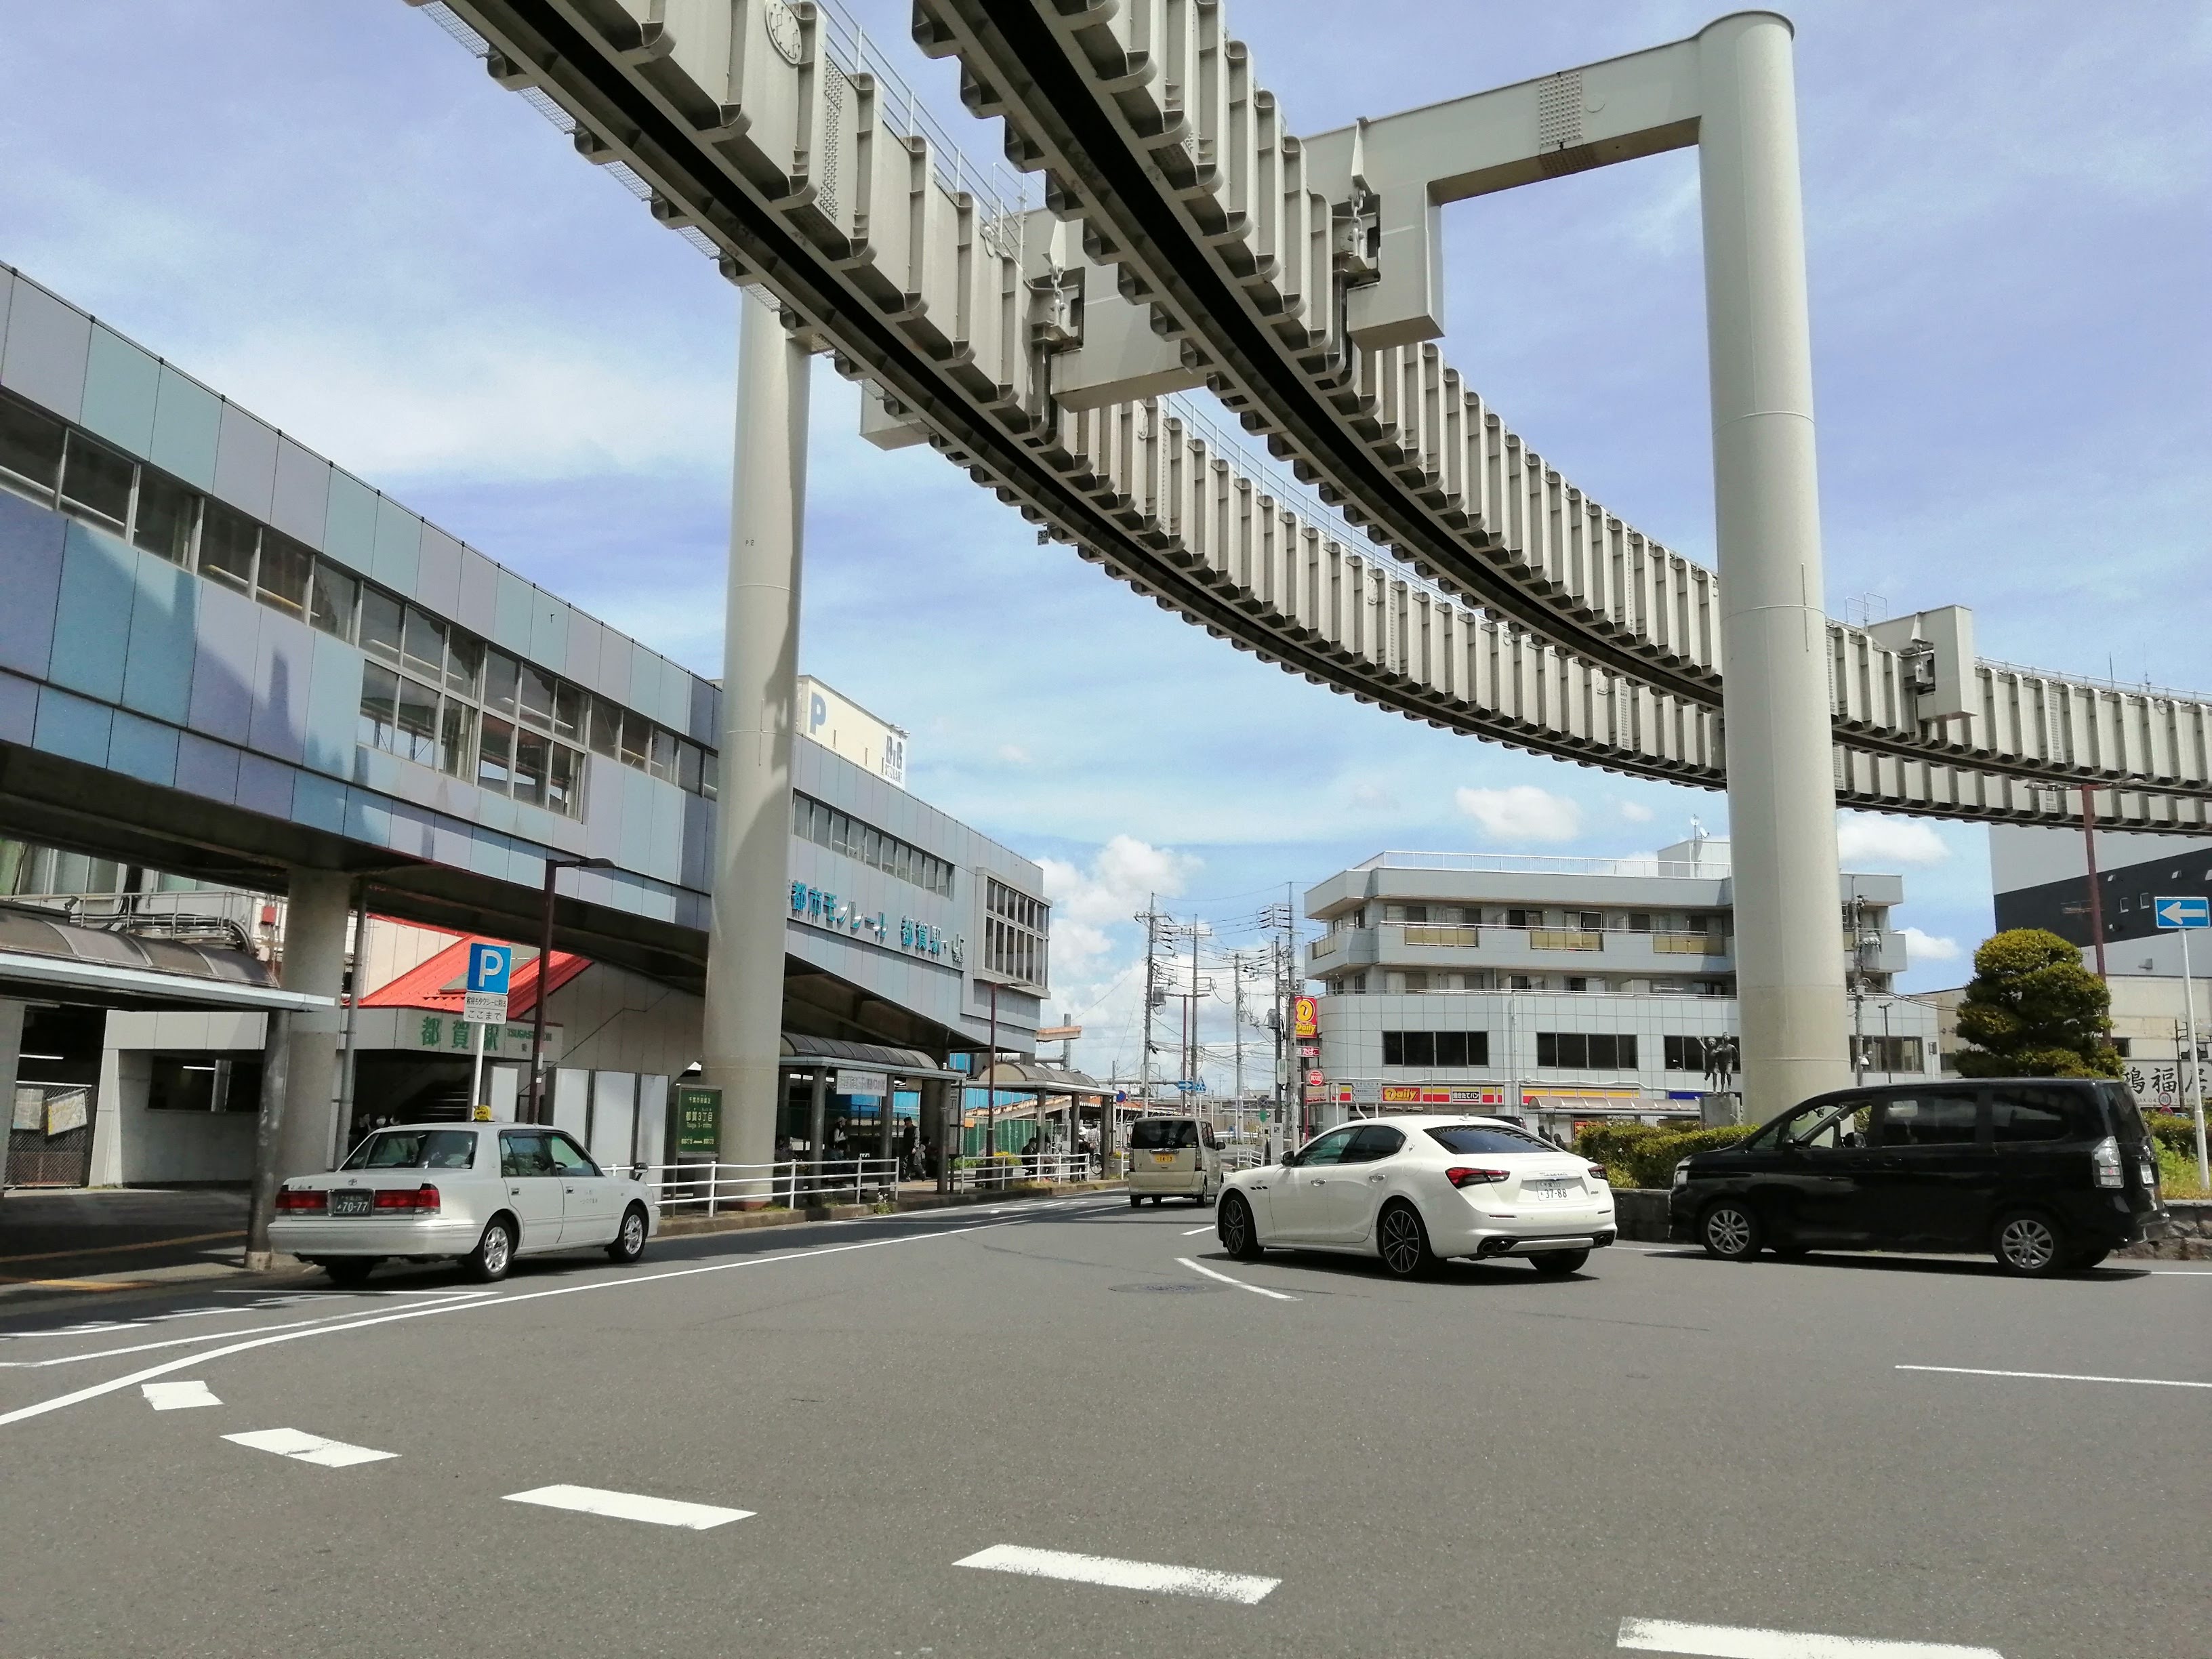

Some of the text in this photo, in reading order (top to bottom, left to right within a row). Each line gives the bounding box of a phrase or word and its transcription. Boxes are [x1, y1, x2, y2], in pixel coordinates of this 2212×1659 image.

[810, 692, 827, 735] P
[478, 949, 504, 988] P
[468, 1010, 501, 1021] ここまで
[1303, 1047, 1319, 1059] たばこ
[1384, 1088, 1417, 1101] Daily
[1544, 1188, 1568, 1199] 37-88
[342, 1202, 368, 1212] 70-77
